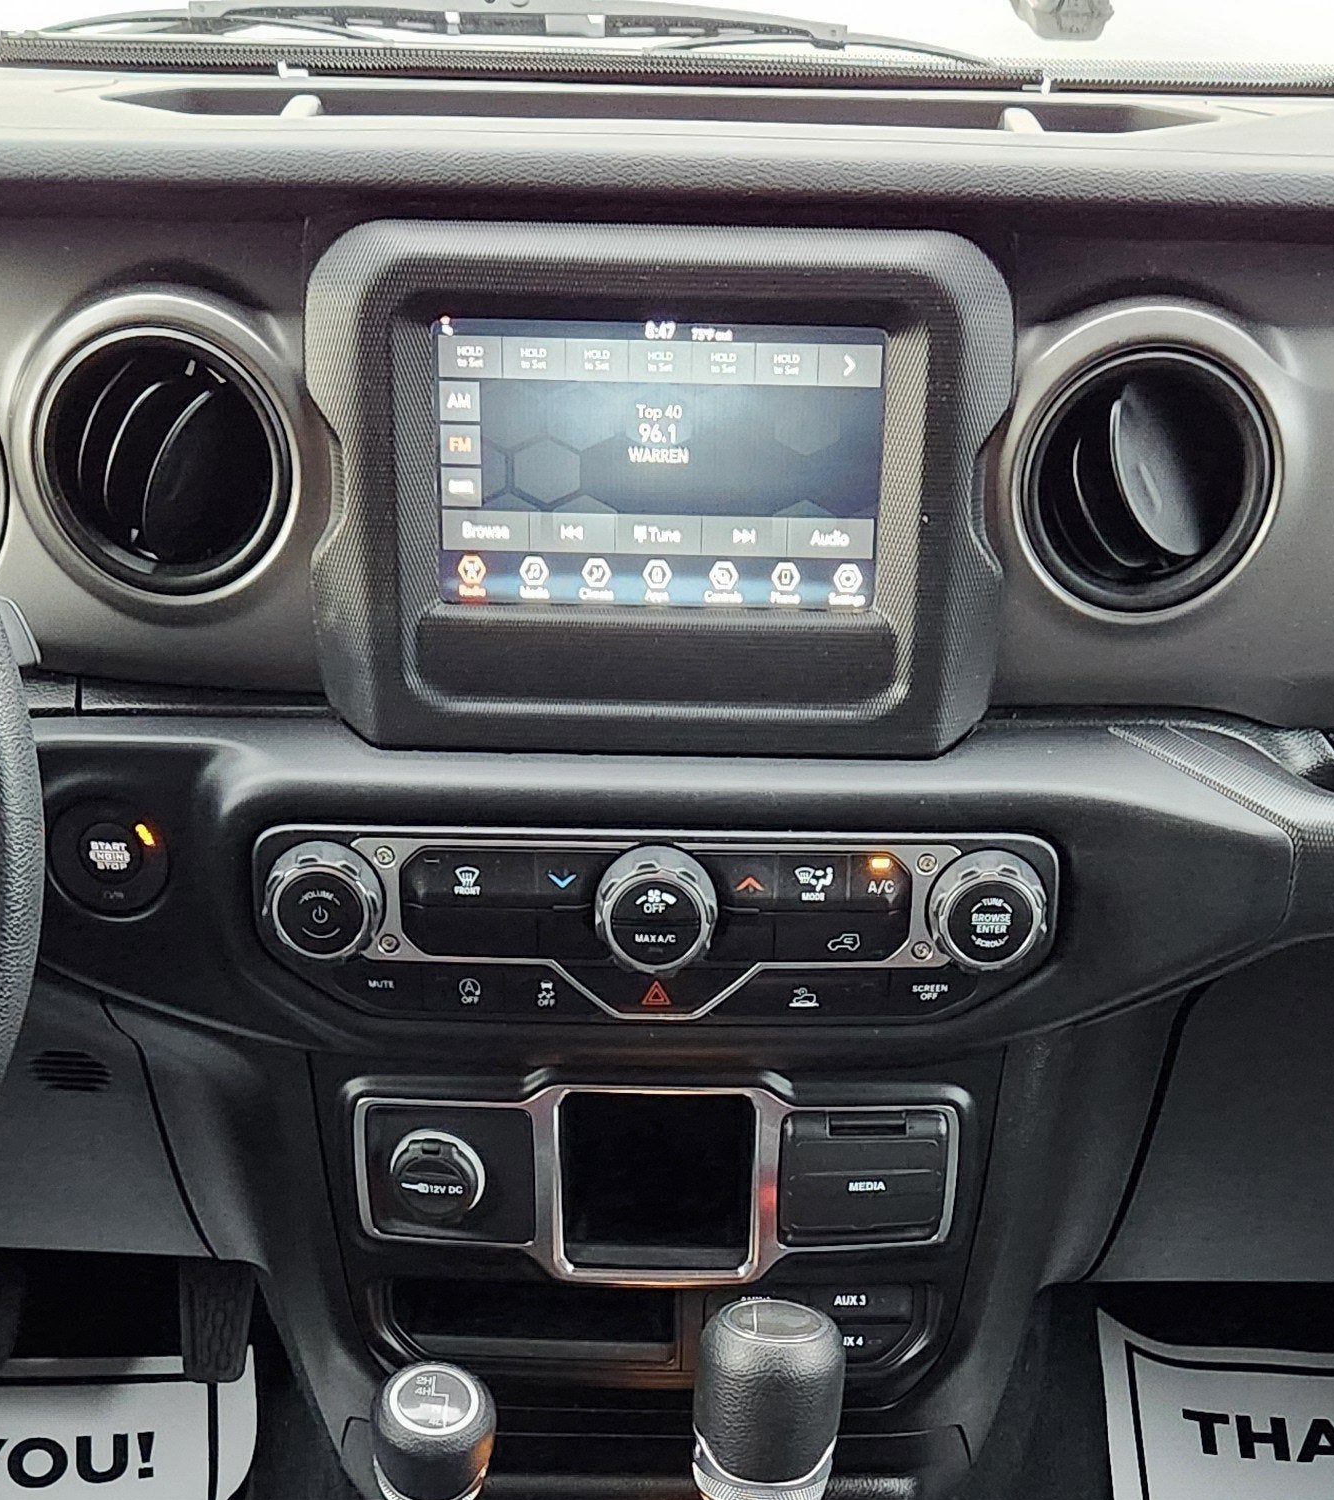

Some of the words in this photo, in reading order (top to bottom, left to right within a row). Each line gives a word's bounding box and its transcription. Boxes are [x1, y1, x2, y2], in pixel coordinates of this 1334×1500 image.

[456, 346, 484, 357] HOLD
[520, 348, 547, 358] HOLD
[584, 350, 610, 360] HOLD
[647, 351, 674, 361] HOLD
[710, 352, 737, 363] HOLD
[773, 354, 801, 364] HOLD
[447, 393, 471, 409] AM
[636, 404, 662, 421] Top
[665, 404, 682, 419] 40
[638, 423, 677, 444] 96.1
[448, 437, 471, 452] FM
[628, 446, 689, 464] WARREN
[462, 521, 510, 540] Browse
[648, 527, 681, 543] Tune
[810, 530, 850, 547] Audio
[90, 841, 127, 851] START
[97, 861, 127, 870] STOP
[868, 880, 895, 894] A/C
[643, 902, 667, 914] OFF
[971, 913, 1012, 923] BROWSE
[976, 924, 1007, 934] ENTER
[634, 933, 656, 943] MAX
[657, 934, 677, 944] A/C
[368, 979, 395, 989] MUTE
[911, 984, 949, 993] SCREEN
[461, 996, 479, 1005] OFF
[919, 992, 939, 1001] OFF
[537, 999, 556, 1007] OFF
[429, 1184, 447, 1194] 12V
[448, 1185, 464, 1195] DC
[848, 1181, 886, 1191] MEDIA
[834, 1295, 858, 1306] AUX
